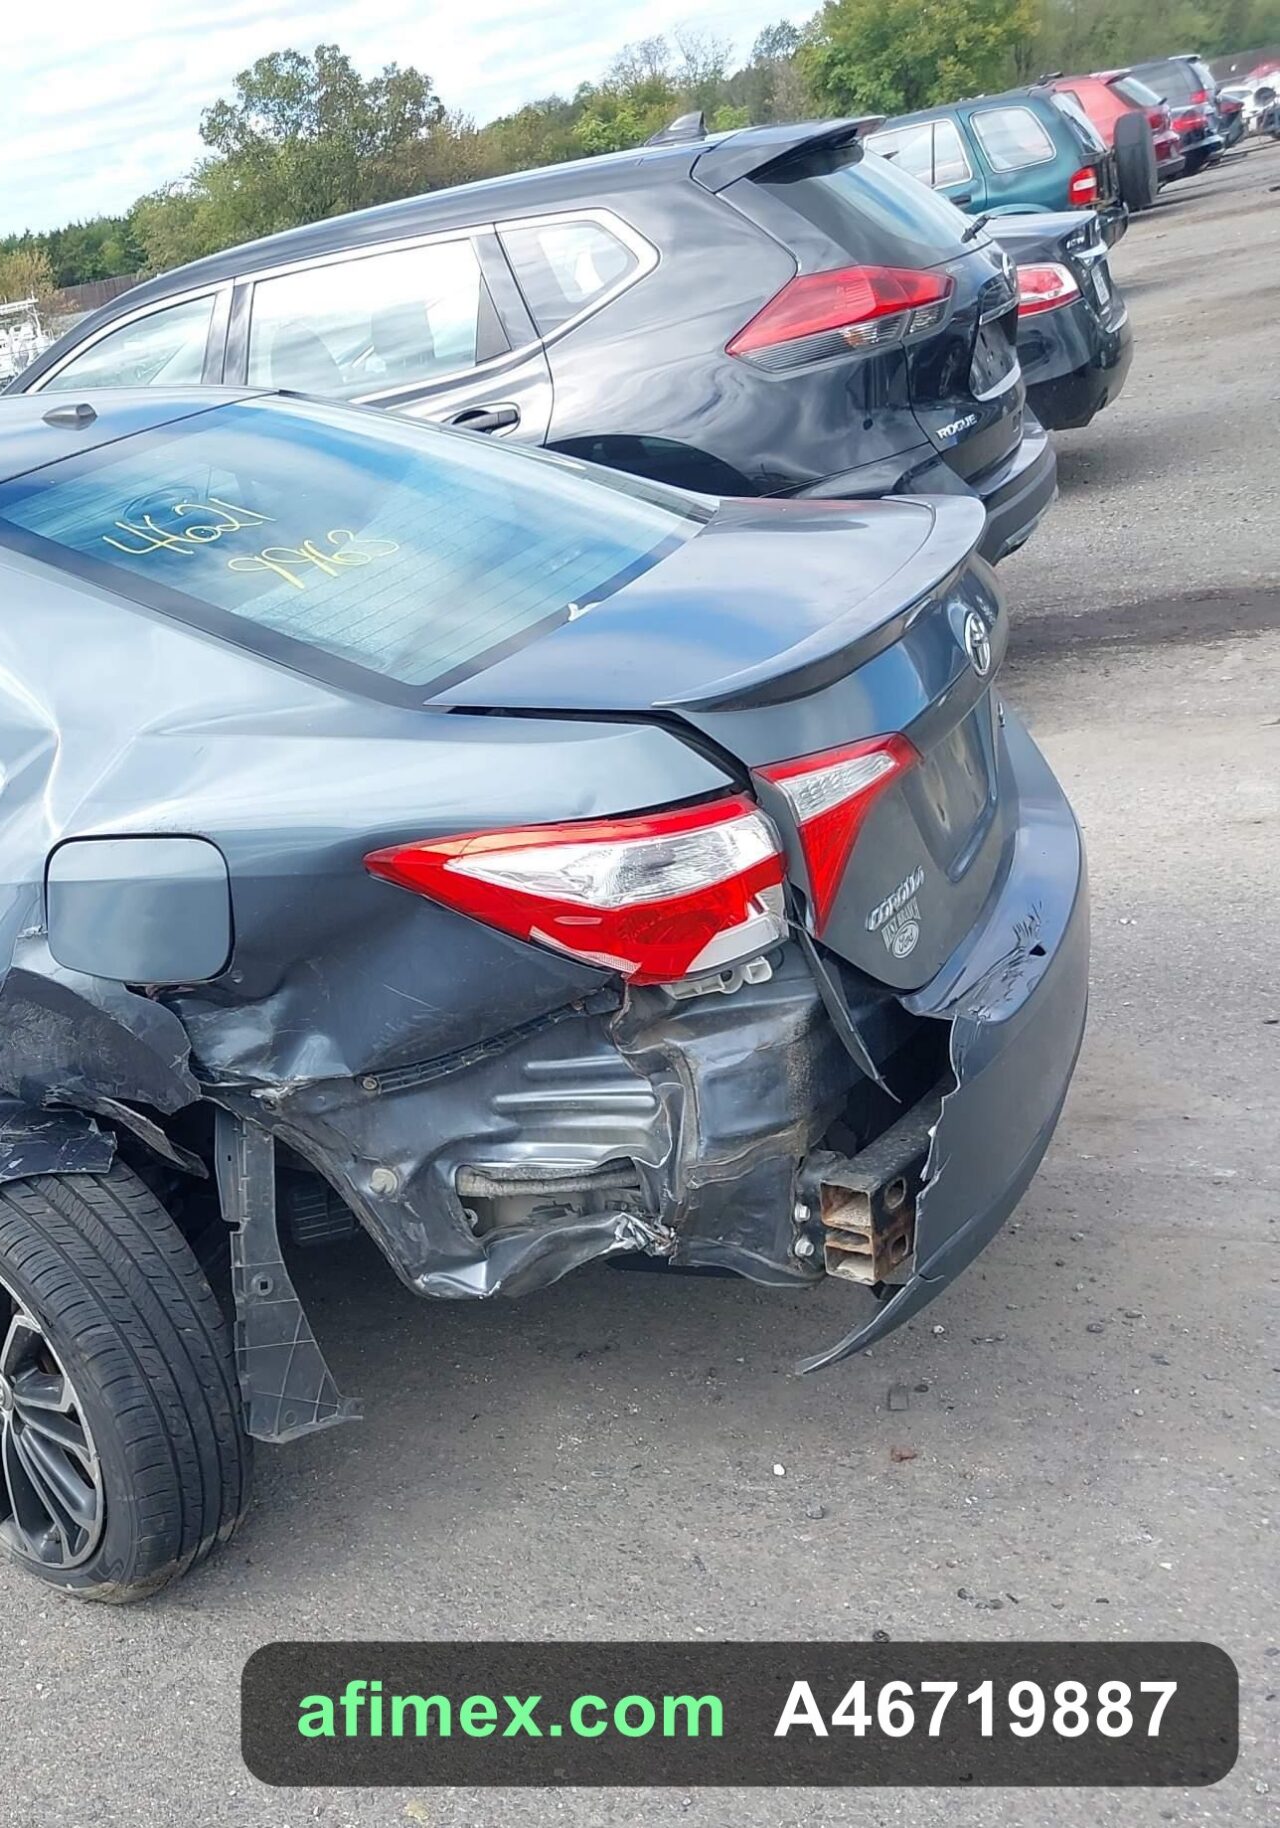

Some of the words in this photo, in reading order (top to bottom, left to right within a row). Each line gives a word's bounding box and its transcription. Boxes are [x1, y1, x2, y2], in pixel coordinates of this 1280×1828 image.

[936, 413, 978, 440] ROGUE
[102, 498, 277, 555] 4621
[228, 530, 400, 589] 9963
[865, 865, 925, 932] COROLLA
